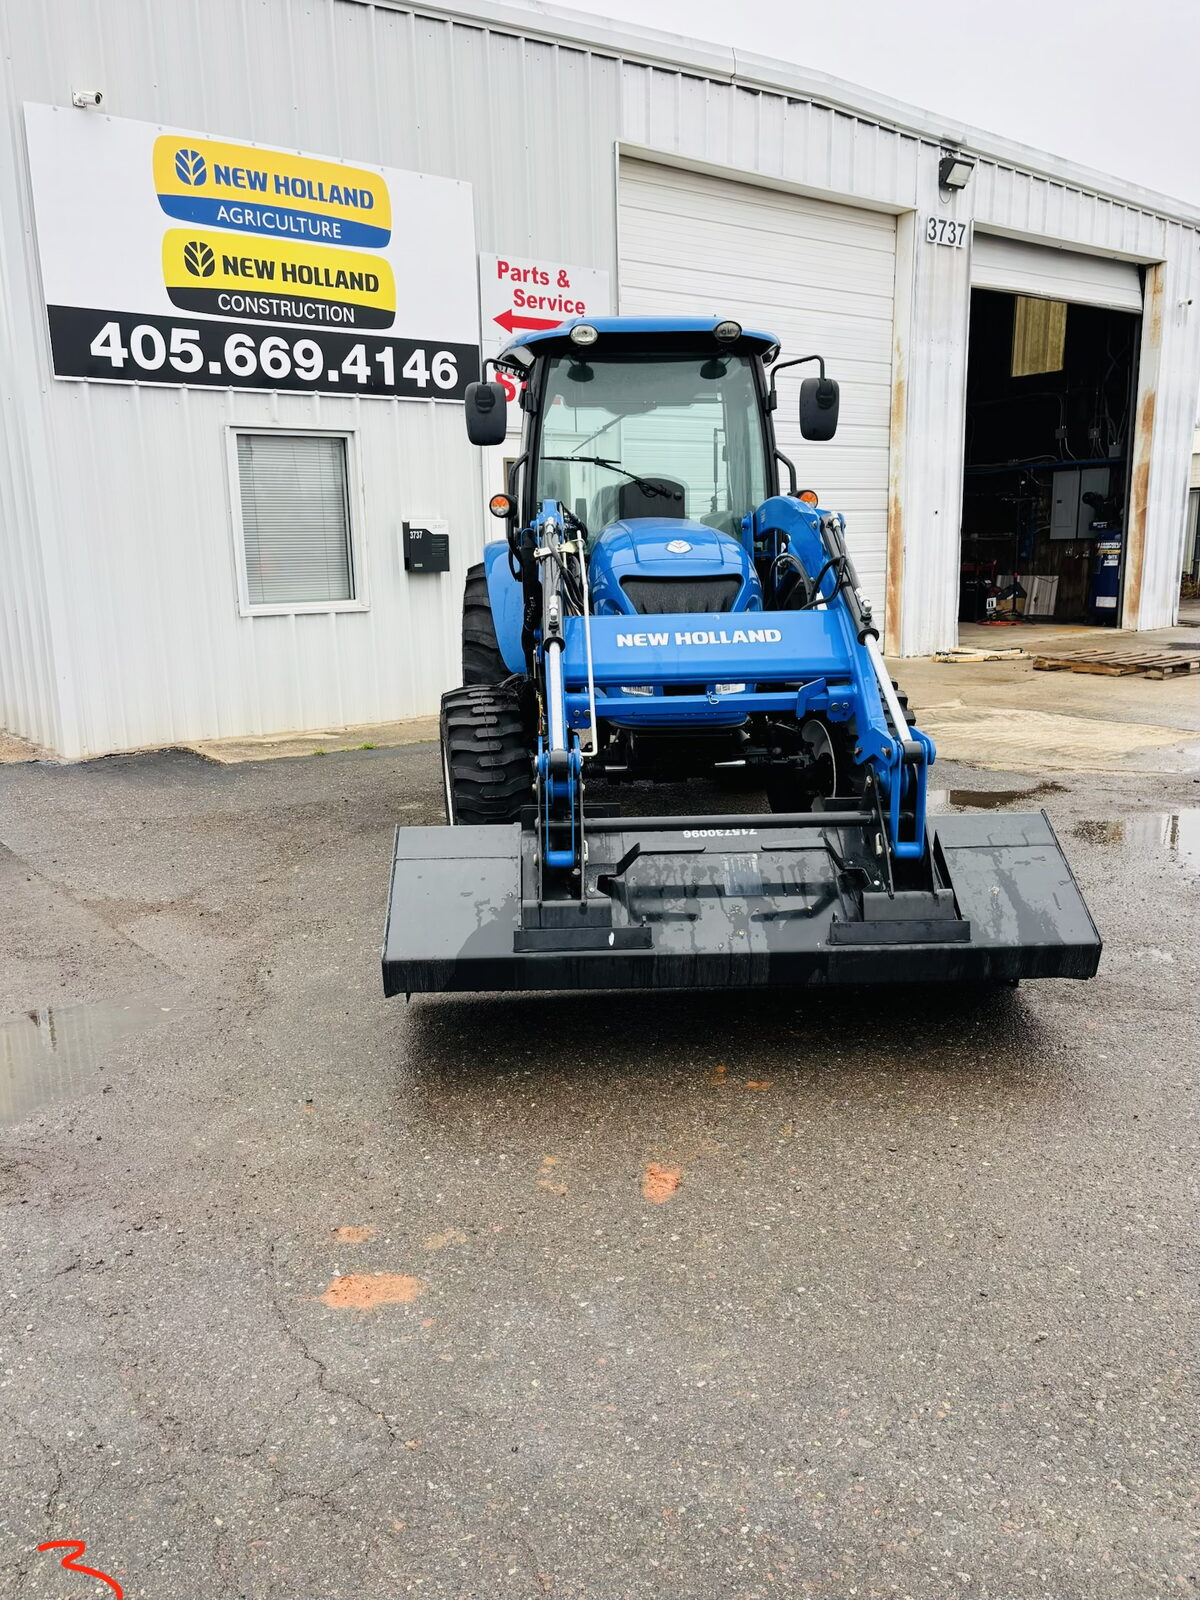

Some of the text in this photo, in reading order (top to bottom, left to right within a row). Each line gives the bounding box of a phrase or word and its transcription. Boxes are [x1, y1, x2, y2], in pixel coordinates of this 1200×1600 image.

[214, 164, 374, 210] NEW HOLLAND
[216, 205, 342, 239] AGRICULTURE
[928, 217, 966, 246] 3737
[222, 255, 379, 293] NEW HOLLAND
[497, 260, 570, 288] Parts &
[217, 293, 355, 323] CONSTRUCTION
[513, 288, 586, 315] Service
[89, 321, 459, 390] 405.669.4146
[409, 530, 423, 540] 3737
[616, 629, 782, 648] NEW HOLLAND
